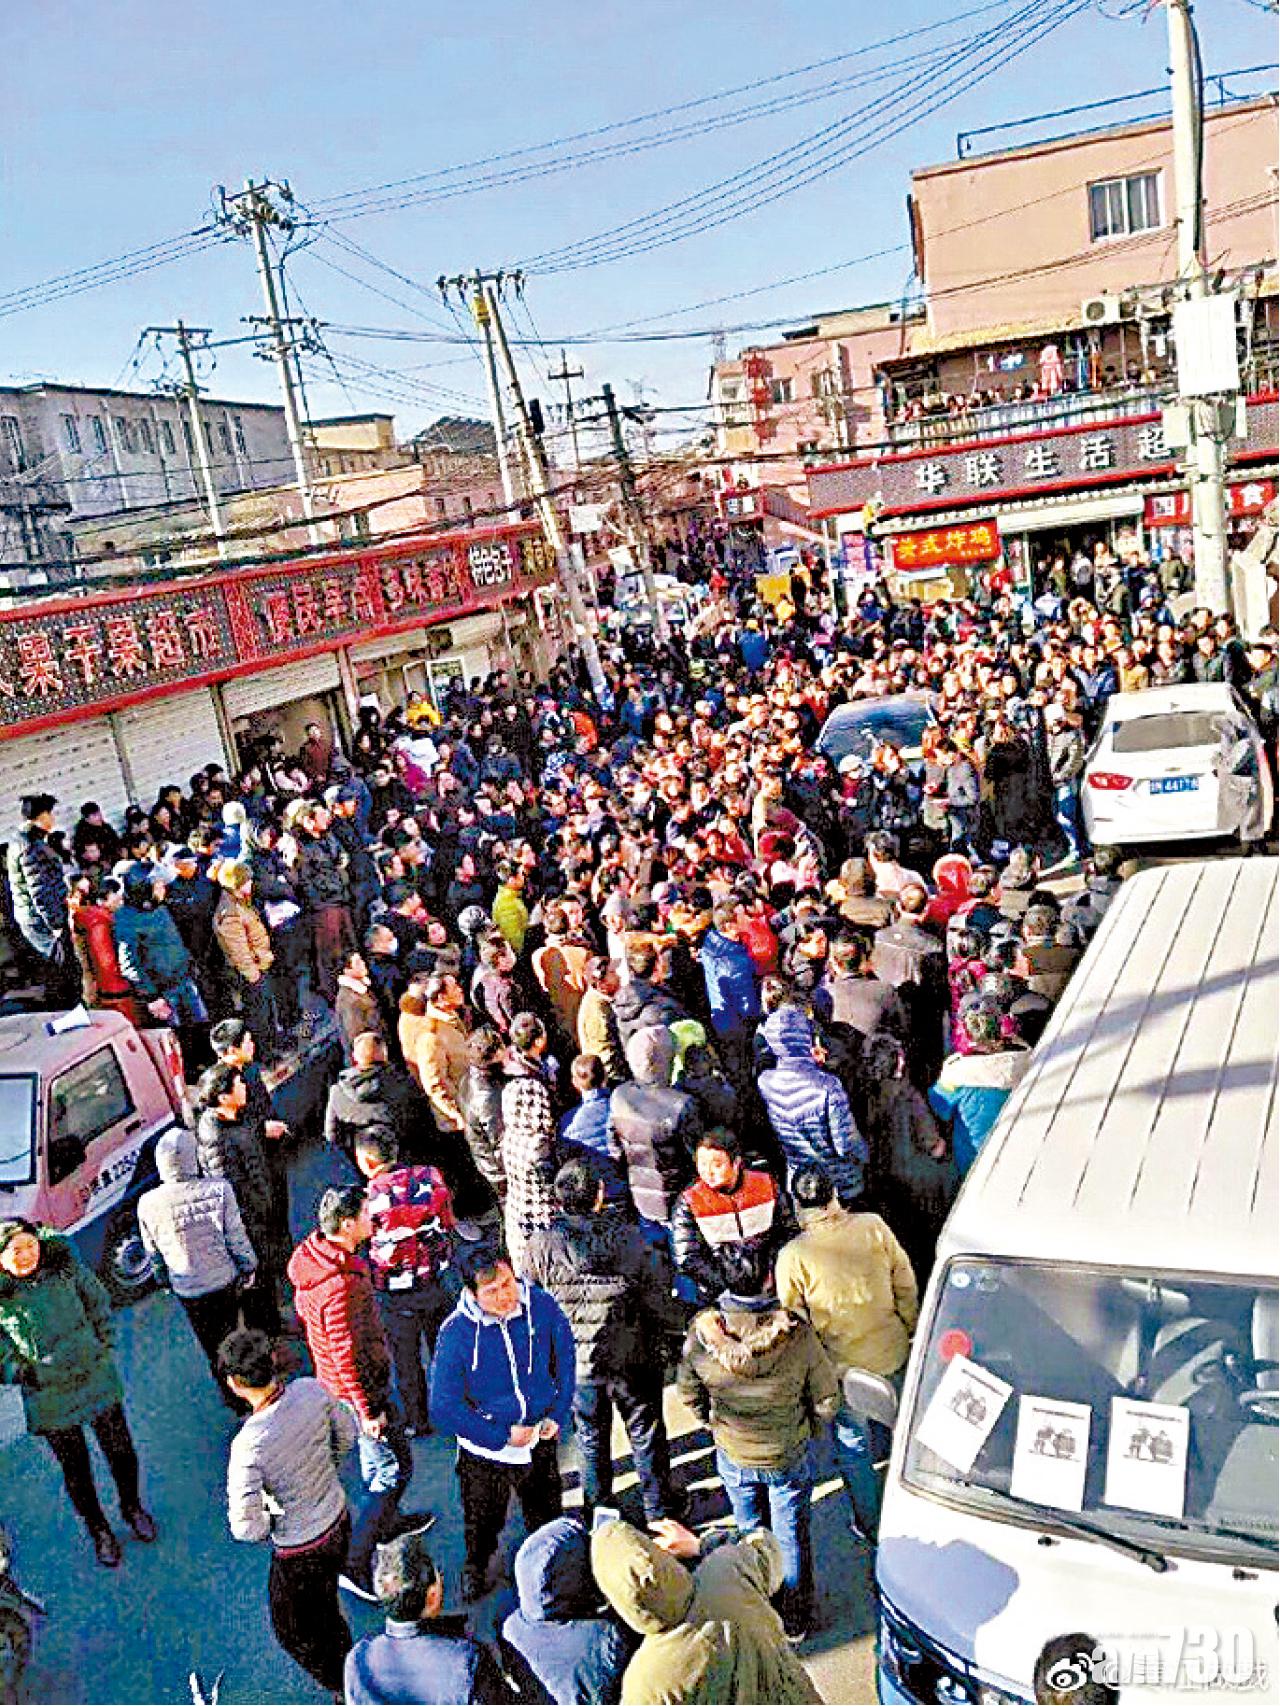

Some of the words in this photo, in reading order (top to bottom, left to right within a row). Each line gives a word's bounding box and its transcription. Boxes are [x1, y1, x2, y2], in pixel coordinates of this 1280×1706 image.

[0, 608, 222, 698] 果干果超市
